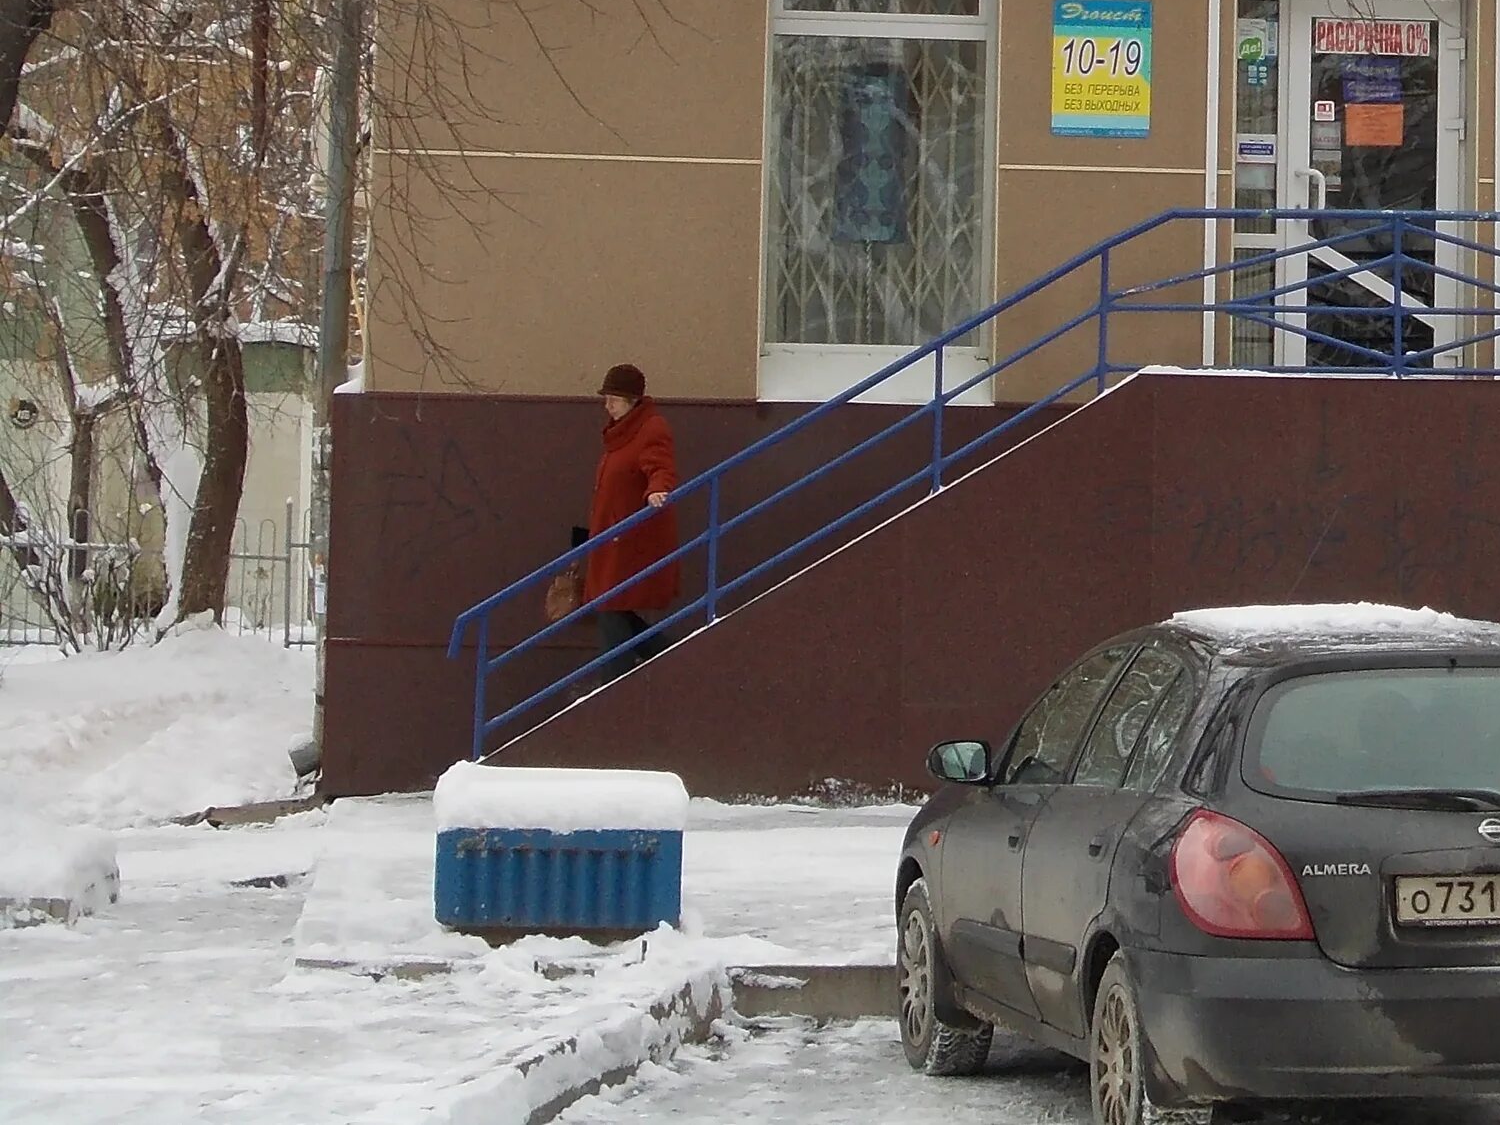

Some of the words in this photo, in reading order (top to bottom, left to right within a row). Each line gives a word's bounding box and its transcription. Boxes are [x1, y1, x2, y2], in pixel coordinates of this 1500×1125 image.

[1316, 21, 1403, 53] РАССРОЧКА
[1406, 24, 1429, 54] 0%
[1063, 38, 1141, 75] 10-19
[1064, 83, 1083, 95] БЕЗ
[1087, 84, 1140, 97] ПЕРЕРЫВА
[1064, 99, 1082, 110] БЕЗ
[1084, 100, 1141, 112] ВЫХОДНЫХ
[1302, 863, 1371, 876] ALMERA
